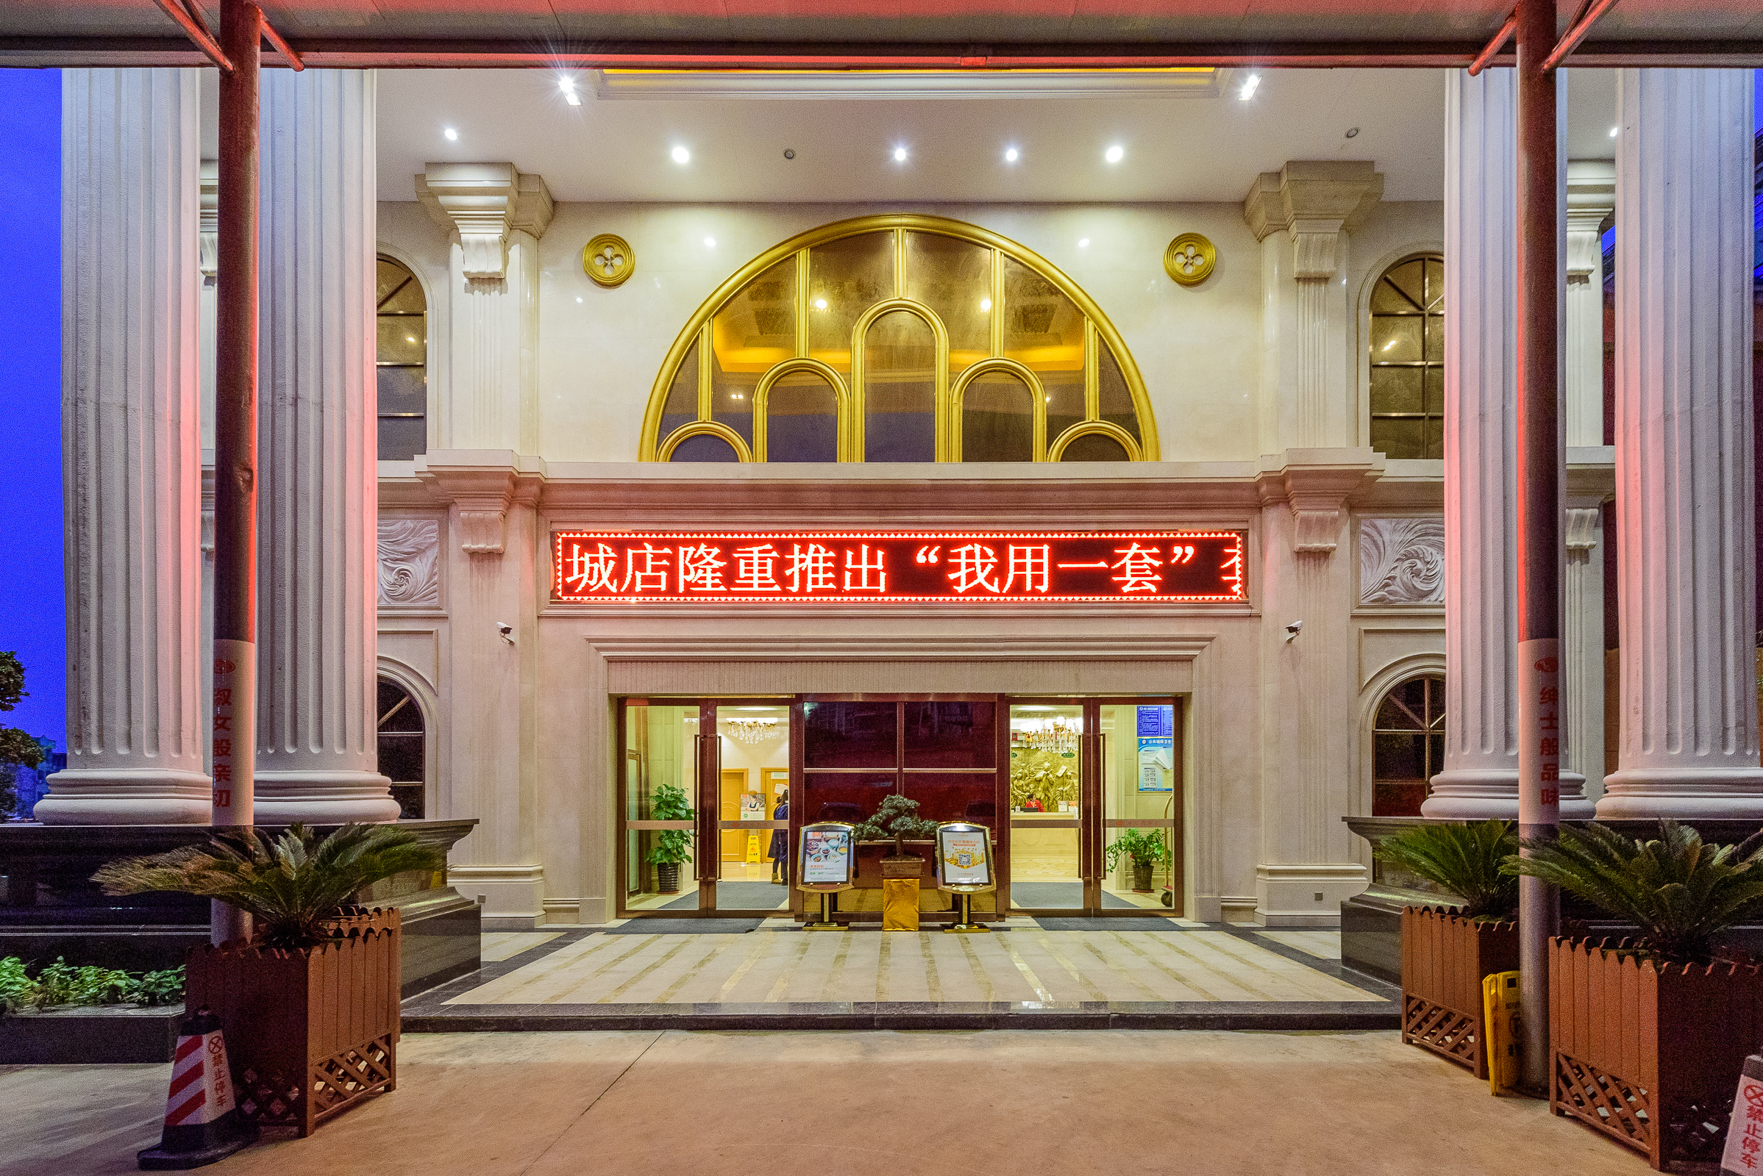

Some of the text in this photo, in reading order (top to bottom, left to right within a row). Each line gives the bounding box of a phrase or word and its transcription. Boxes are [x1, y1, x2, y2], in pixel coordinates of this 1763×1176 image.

[1539, 686, 1559, 806] 绅士般品味
[212, 1053, 227, 1107] 禁止停车
[1740, 1105, 1763, 1169] 禁止停车
